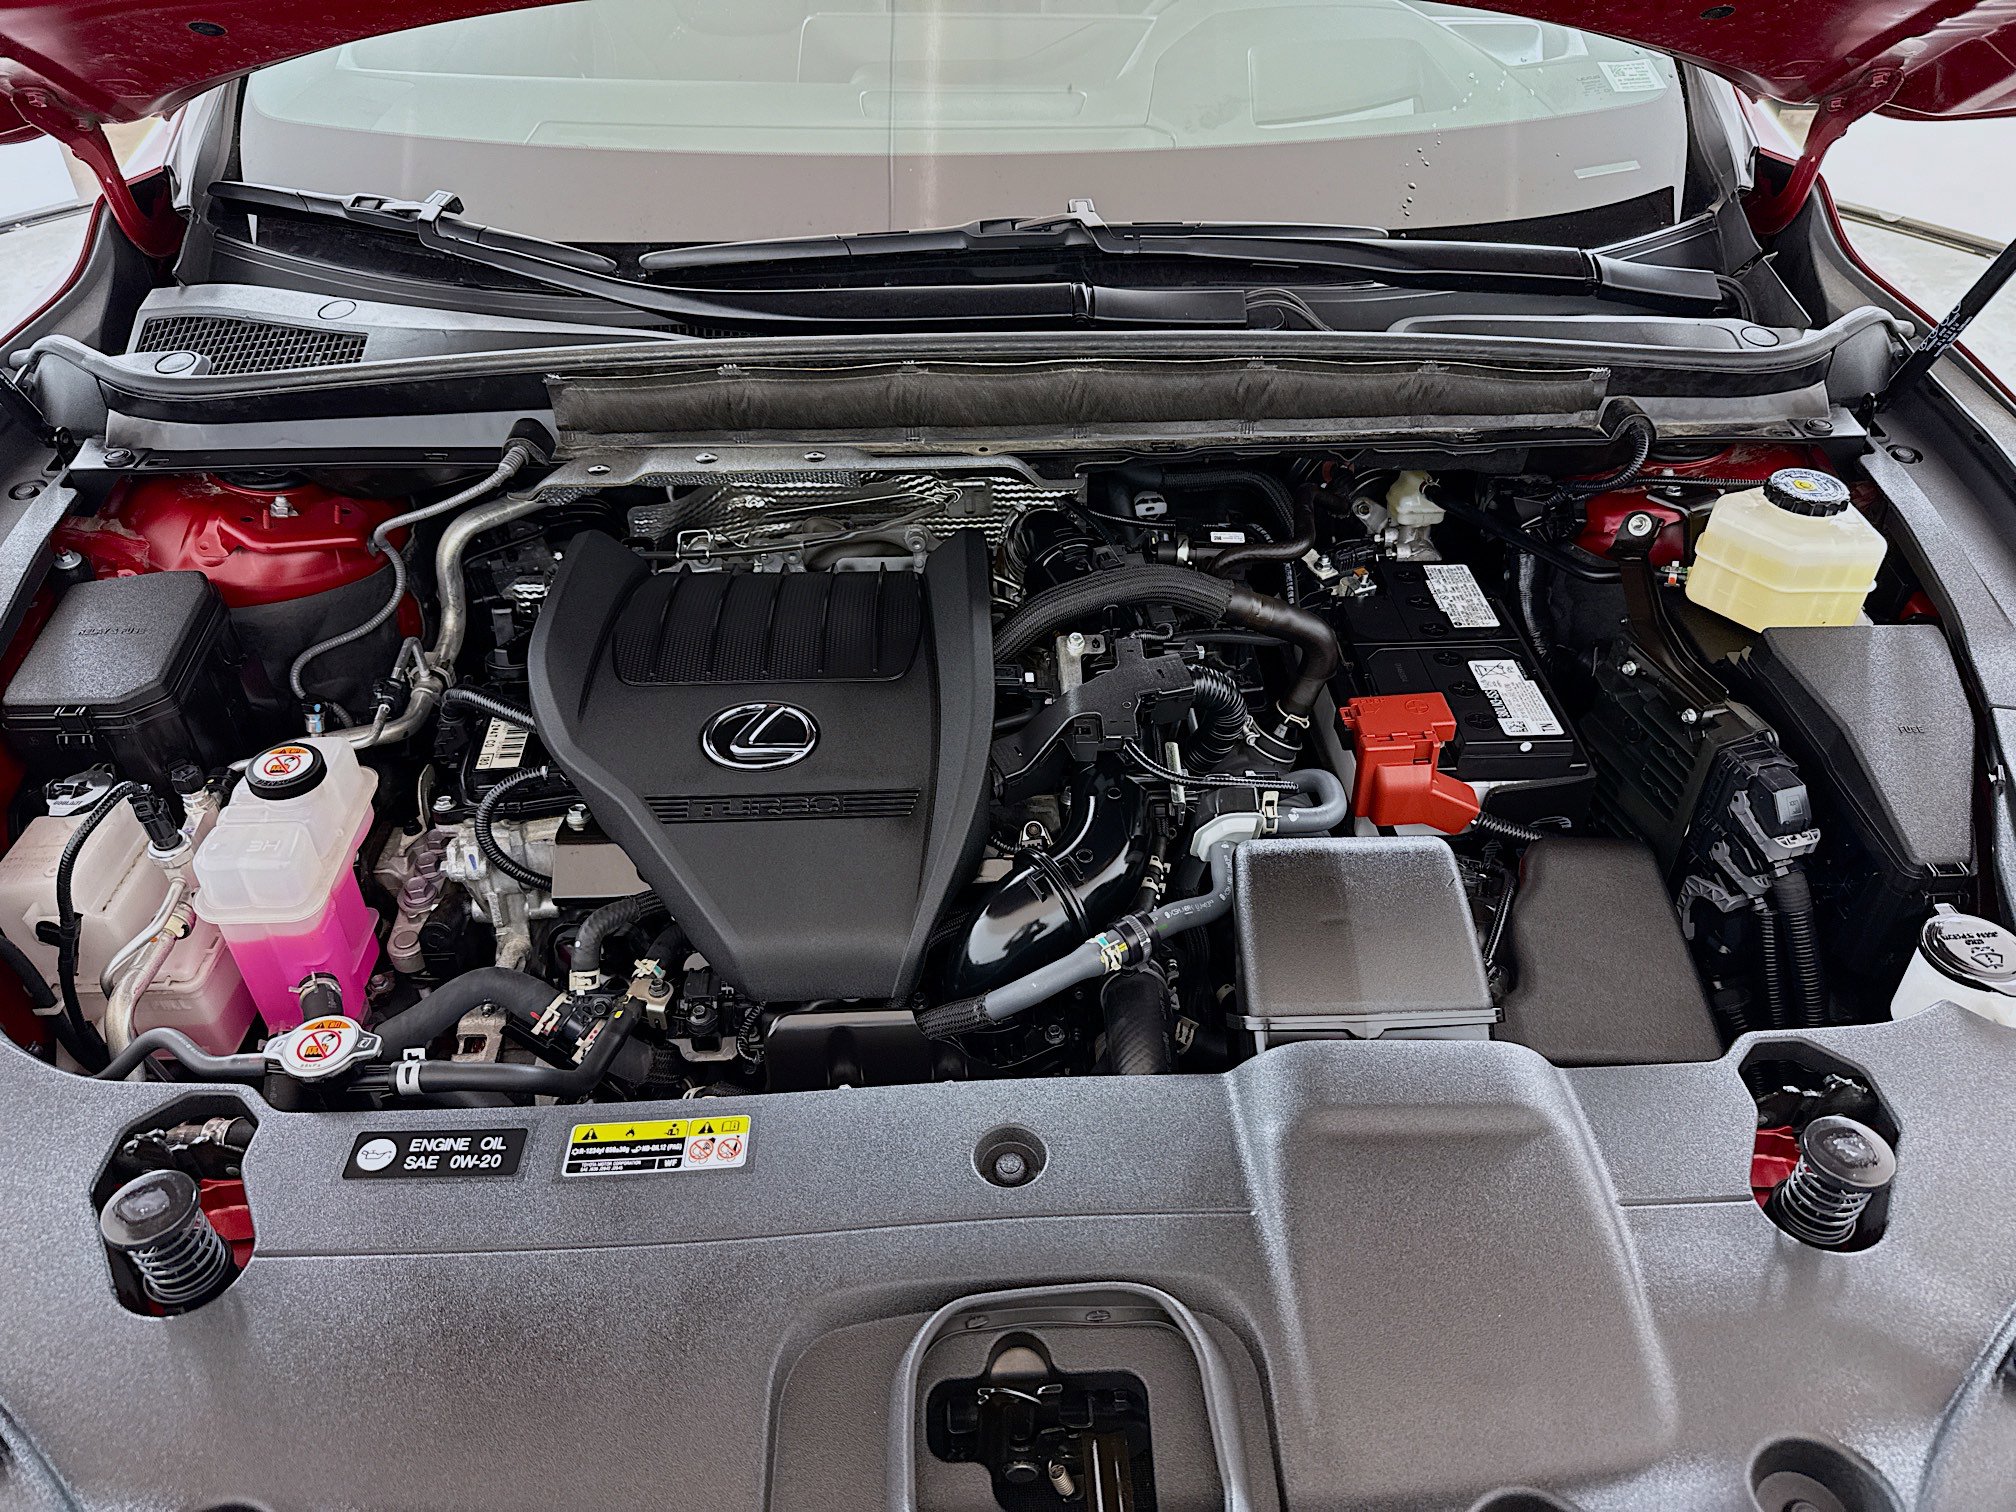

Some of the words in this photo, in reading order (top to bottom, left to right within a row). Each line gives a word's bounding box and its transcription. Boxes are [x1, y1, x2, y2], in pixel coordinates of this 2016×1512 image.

[692, 795, 840, 817] TURBO
[409, 1137, 471, 1152] ENGINE
[480, 1136, 507, 1151] OIL
[403, 1155, 440, 1170] SAE
[449, 1153, 502, 1169] 0W-20
[664, 1158, 678, 1167] WF
